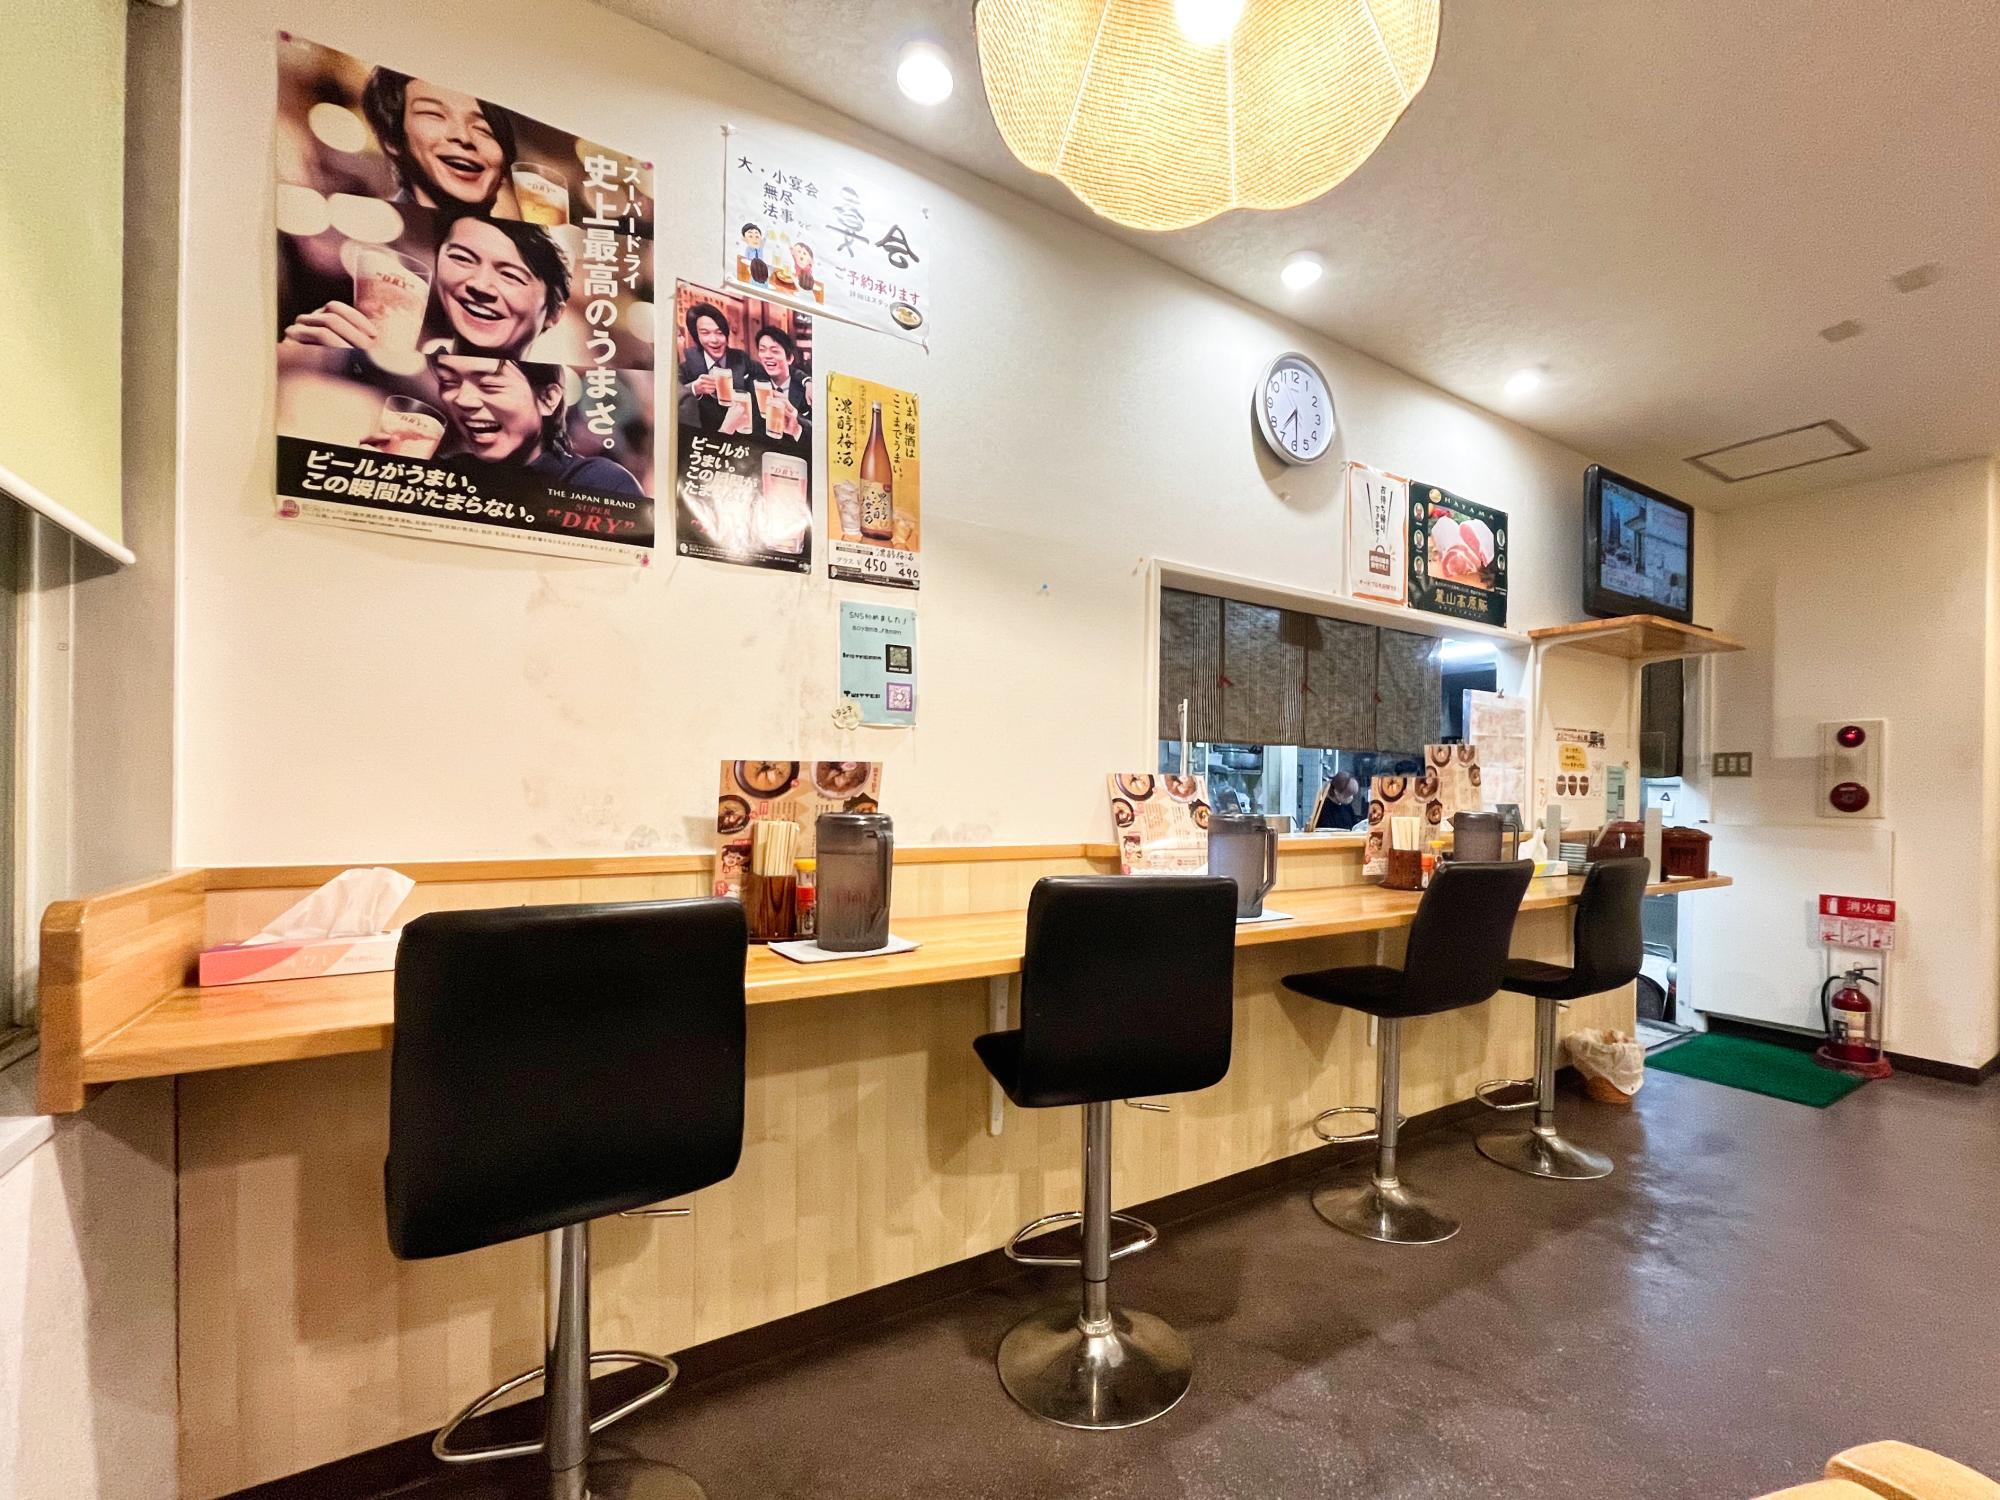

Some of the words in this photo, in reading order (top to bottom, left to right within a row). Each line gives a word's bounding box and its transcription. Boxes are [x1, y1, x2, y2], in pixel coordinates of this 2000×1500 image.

[763, 182, 795, 206] 無尽
[622, 166, 643, 289] スーパードライ
[834, 266, 920, 306] ご予約承ります
[582, 154, 619, 450] 史上最高のうまさ。
[1291, 371, 1300, 384] 12
[1305, 380, 1309, 392] 1
[1266, 397, 1274, 408] 9
[1311, 395, 1318, 408] 2
[905, 396, 916, 458] いま、梅酒は
[1270, 416, 1278, 428] 8
[1315, 414, 1321, 426] 3
[893, 393, 904, 478] ここまでうまい。
[1279, 431, 1286, 443] 7
[1311, 430, 1318, 442] 4
[692, 436, 750, 459] ビールが
[1291, 440, 1298, 452] 6
[1303, 439, 1310, 451] 5
[690, 451, 735, 472] うまい。
[306, 450, 478, 494] ビールがうまい。
[301, 471, 536, 524] この瞬間がたまらない。
[547, 488, 566, 498] THE
[569, 492, 600, 503] JAPAN
[604, 498, 636, 510] BRAND
[575, 503, 611, 516] SUPER
[1444, 496, 1494, 520] HAYAMA
[864, 557, 887, 573] 450
[898, 568, 919, 579] 490
[1846, 900, 1891, 916] 消火器
